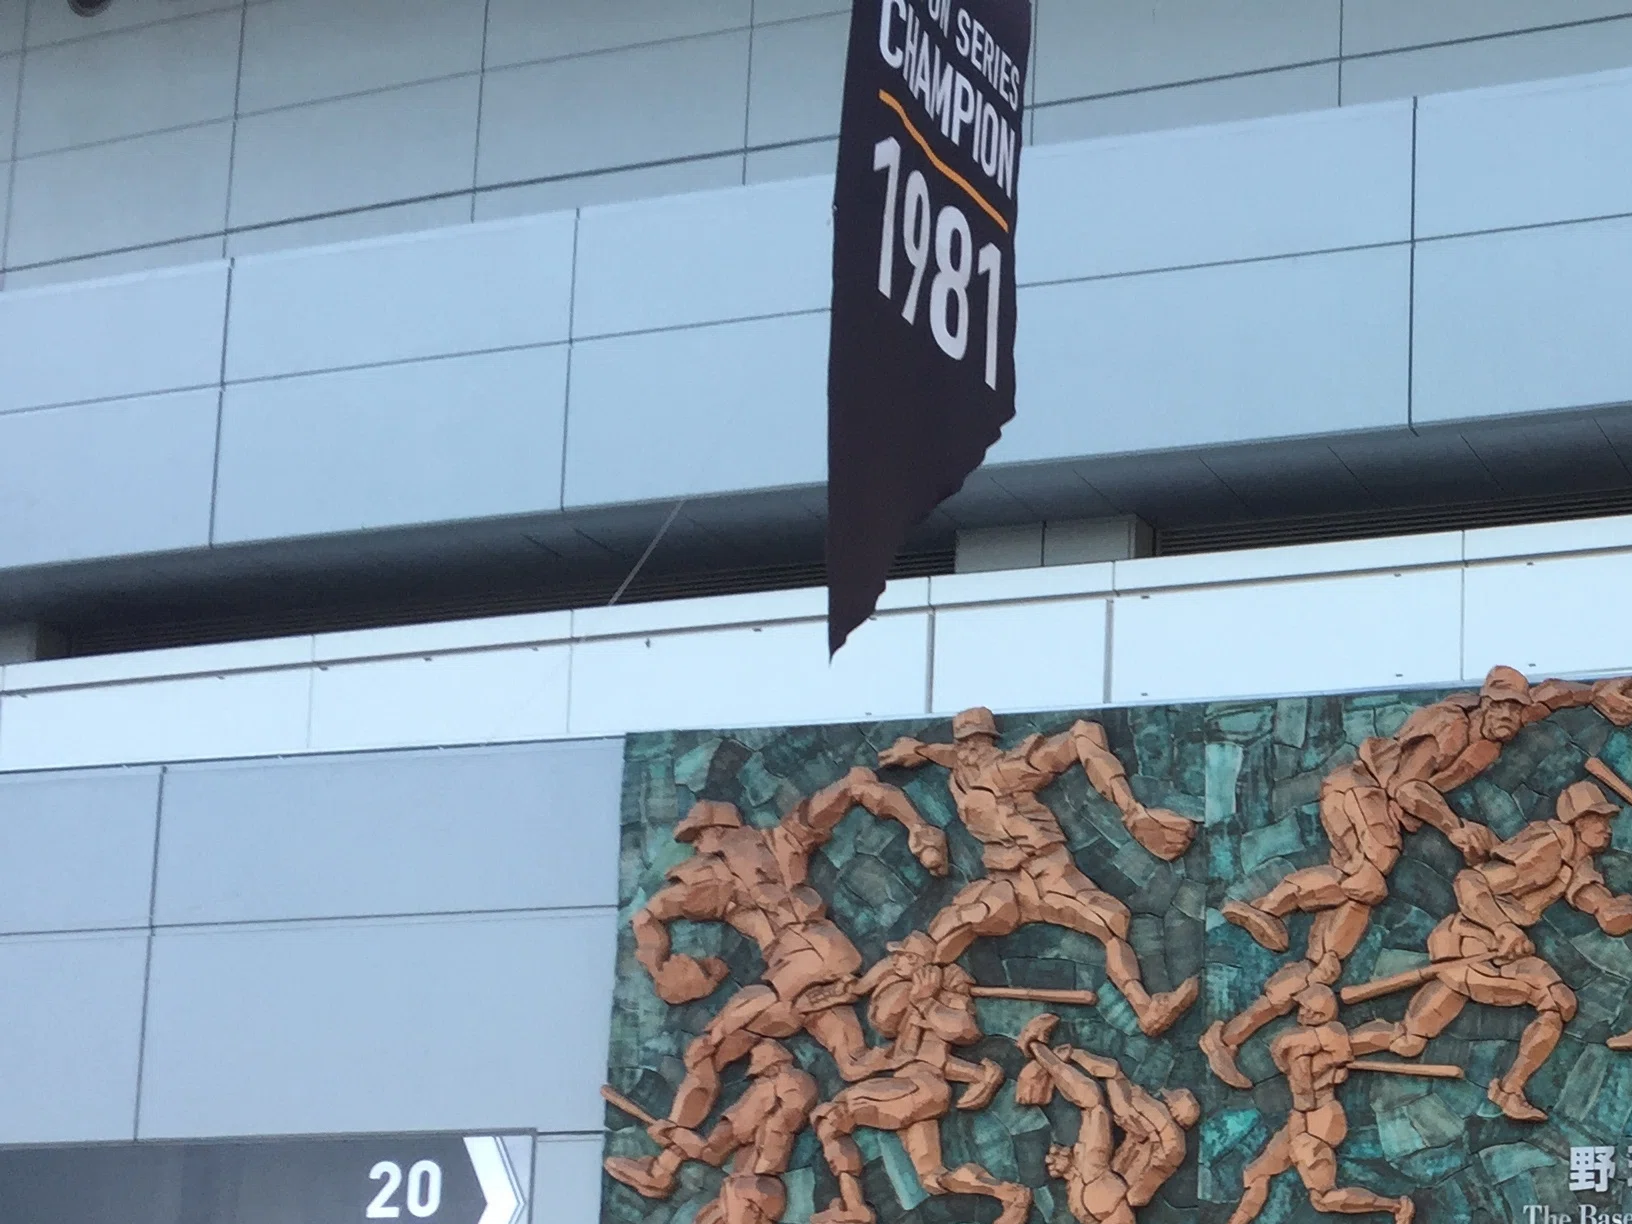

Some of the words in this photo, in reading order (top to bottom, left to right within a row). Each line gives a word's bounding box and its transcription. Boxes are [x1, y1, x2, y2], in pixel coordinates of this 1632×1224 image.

[879, 0, 1016, 201] CHAMPION
[955, 8, 1020, 112] SERIES
[873, 136, 1001, 391] 1981
[366, 1160, 442, 1218] 20
